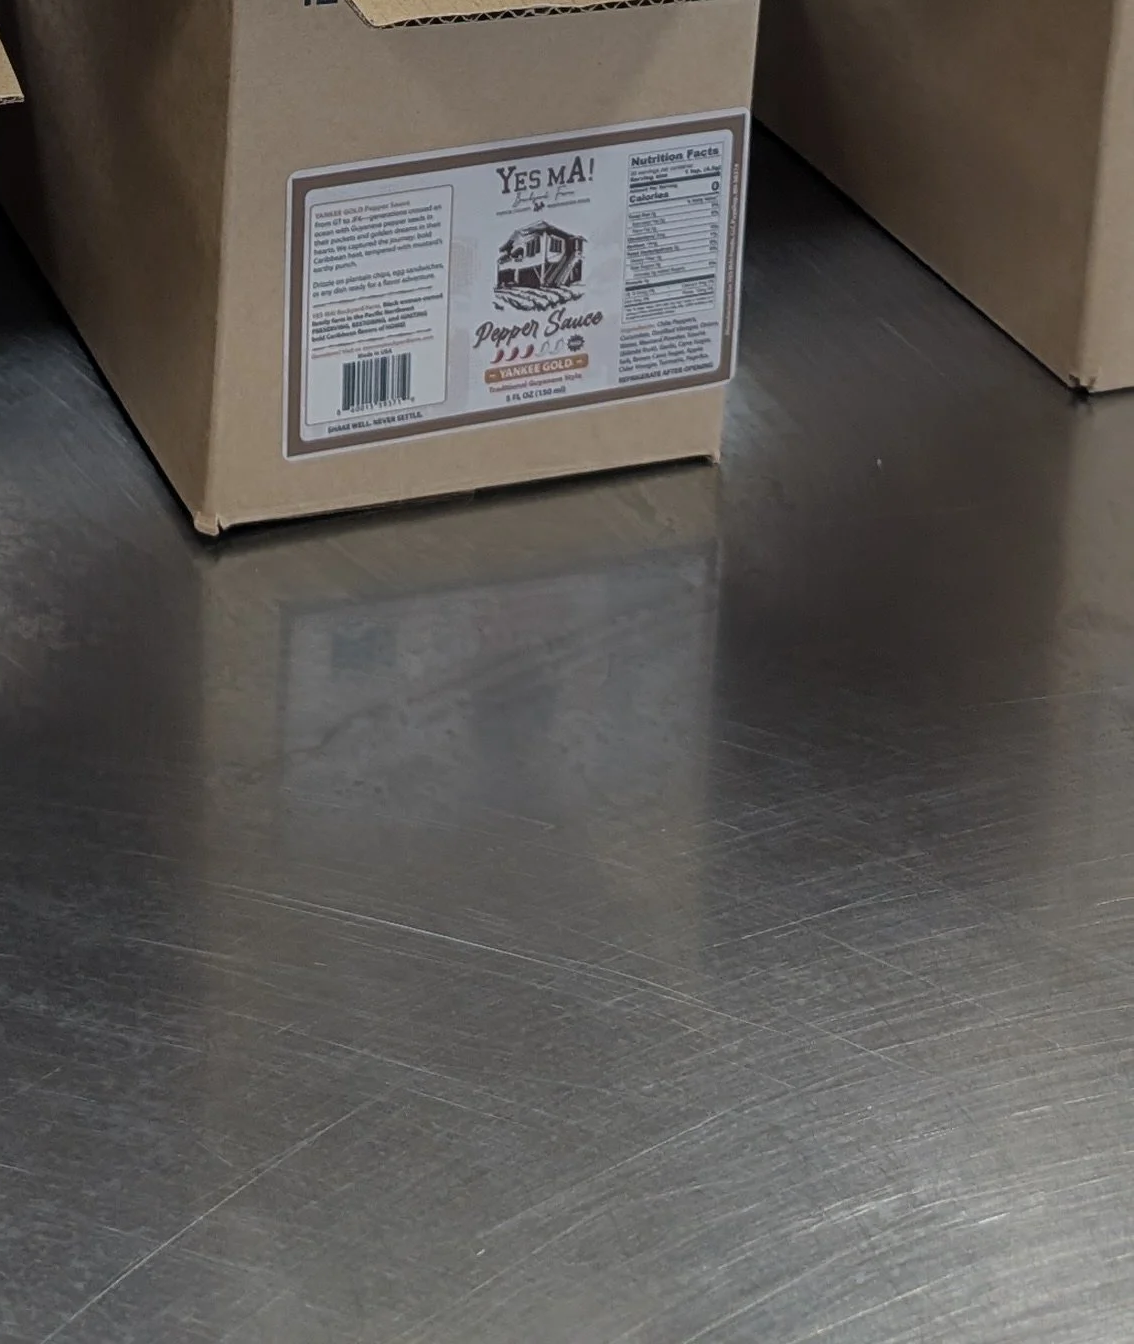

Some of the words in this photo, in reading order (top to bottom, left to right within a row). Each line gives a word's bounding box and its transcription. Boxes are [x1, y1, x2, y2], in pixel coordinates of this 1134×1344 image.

[630, 152, 683, 167] Nutrition
[686, 146, 718, 159] Facts
[495, 165, 541, 195] YES
[472, 319, 539, 349] Pepper
[543, 307, 604, 338] Sauce
[499, 363, 541, 379] YANKEE
[542, 358, 573, 371] GOLD
